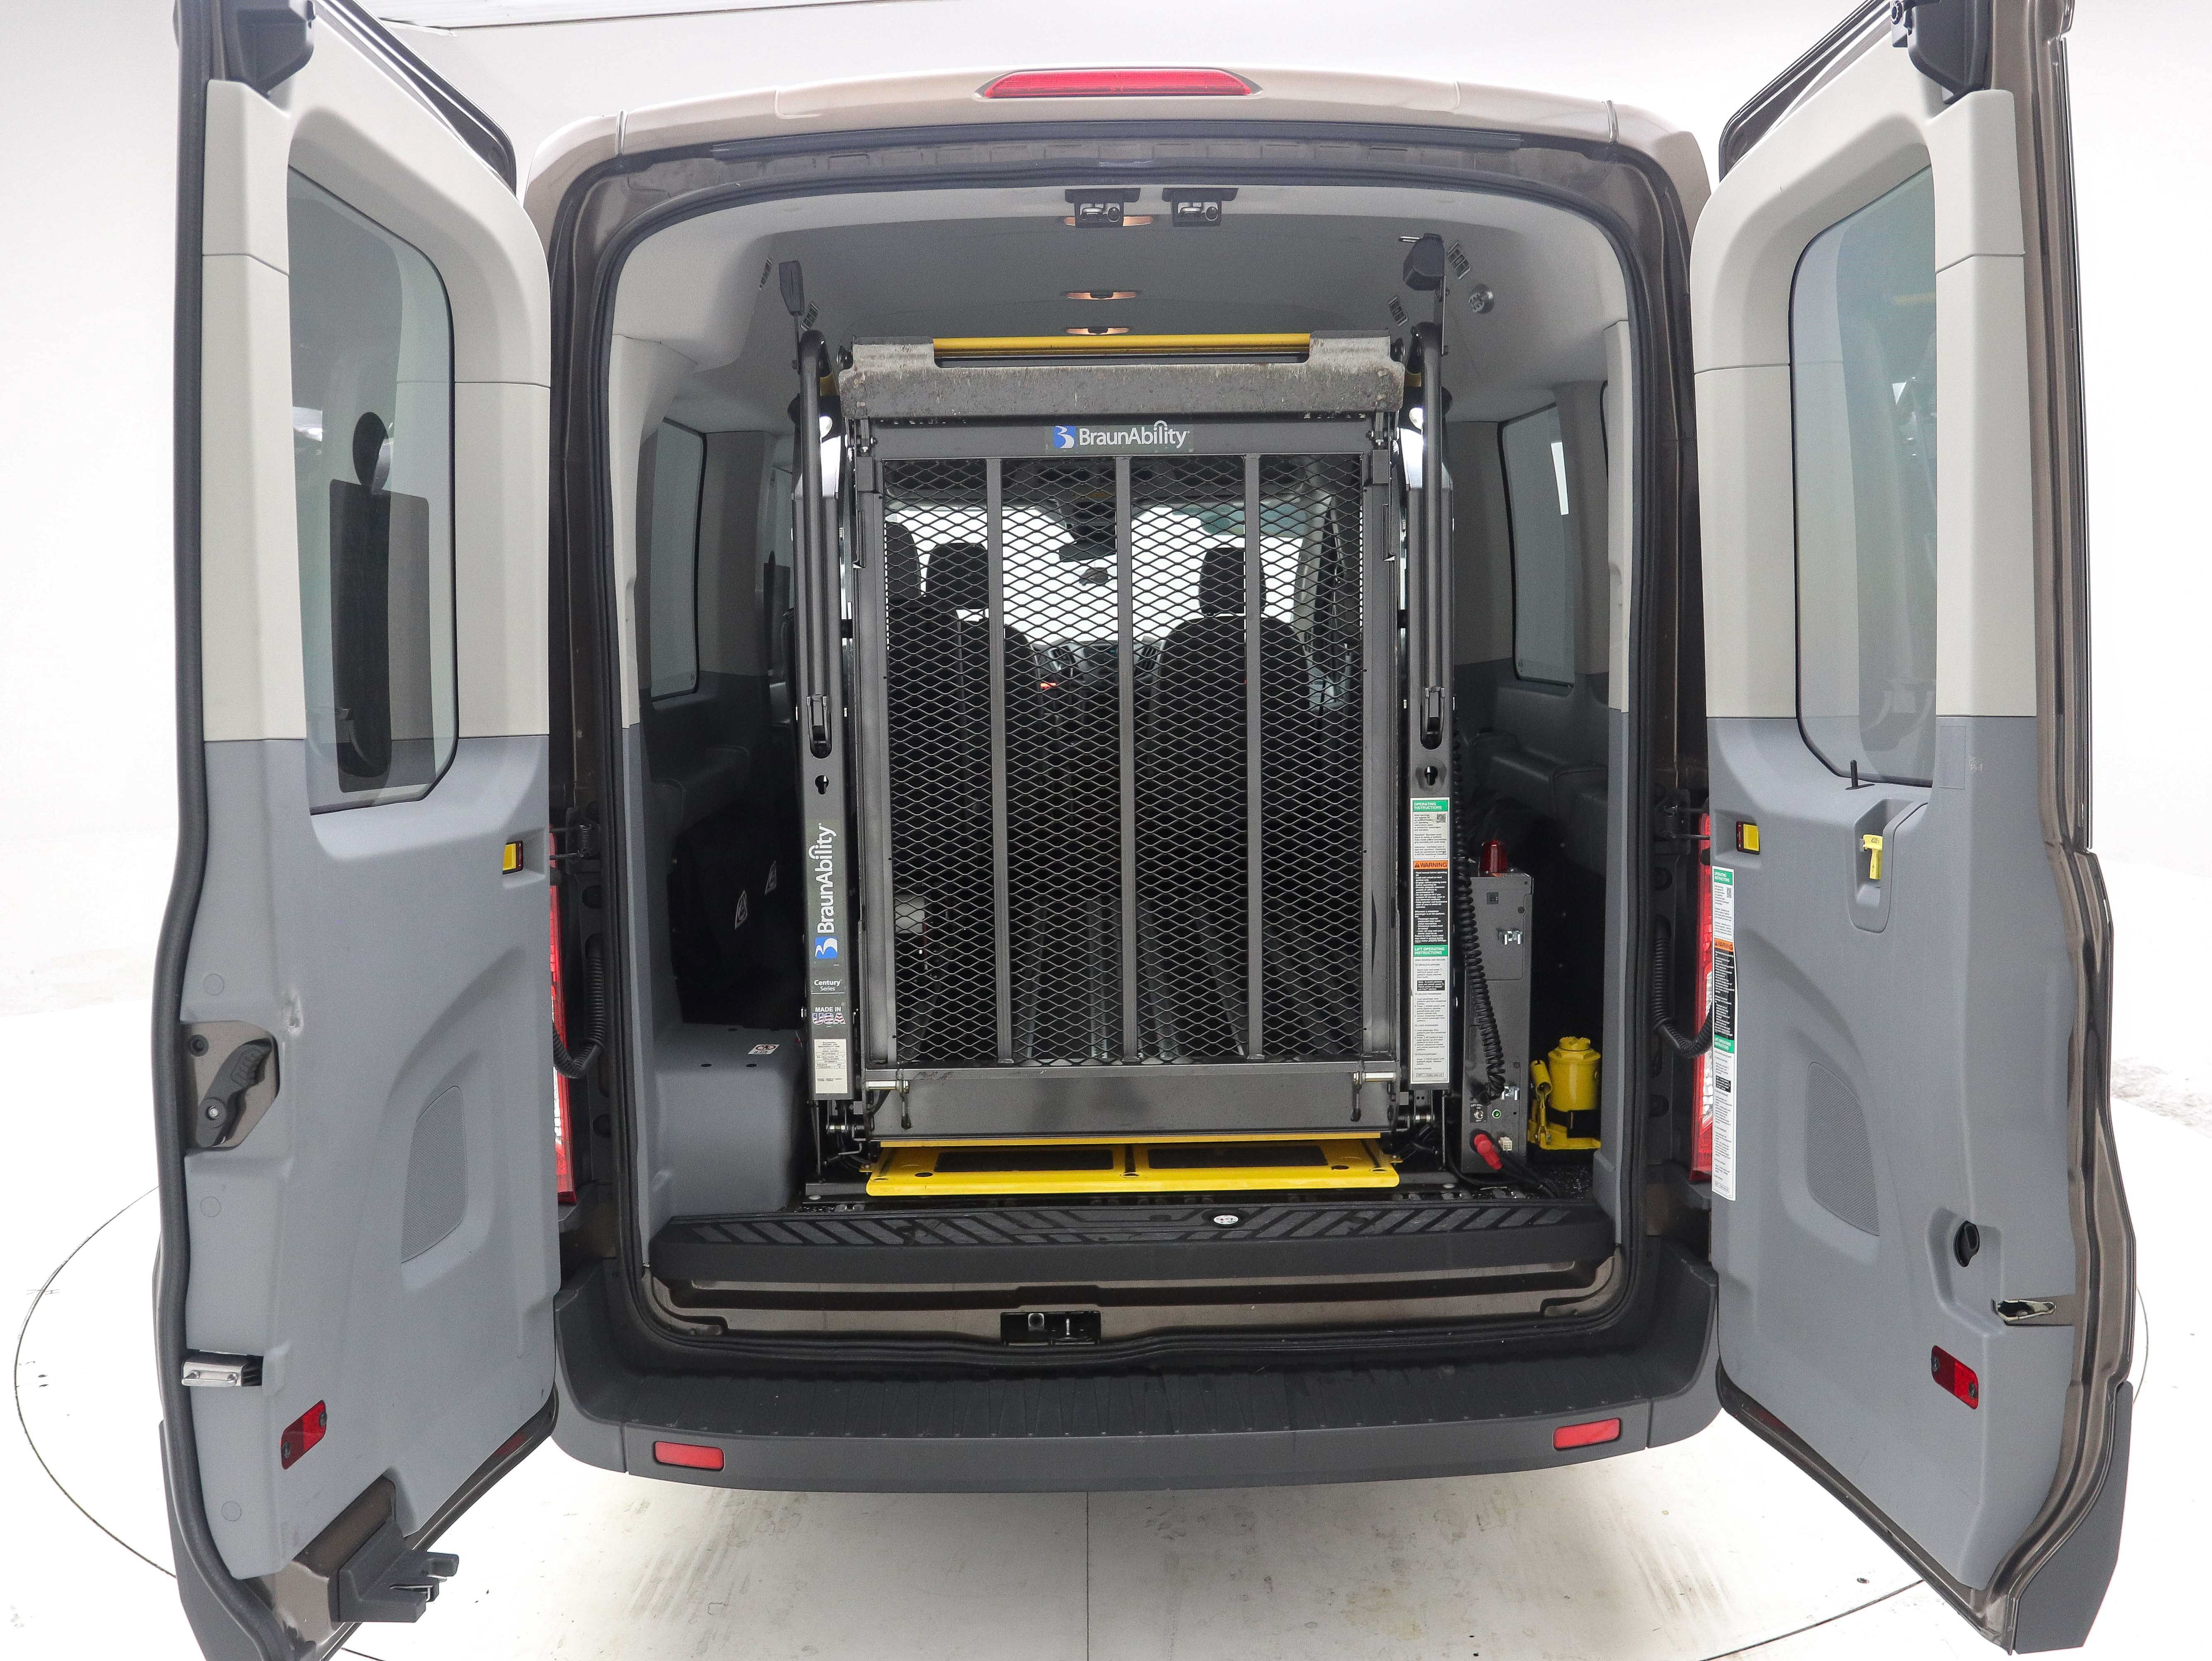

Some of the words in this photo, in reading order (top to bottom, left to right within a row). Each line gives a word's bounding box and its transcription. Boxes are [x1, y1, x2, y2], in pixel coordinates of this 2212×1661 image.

[1079, 420, 1188, 448] BraunAbility
[808, 823, 837, 933] BraunAbility
[812, 1012, 846, 1025] USA
